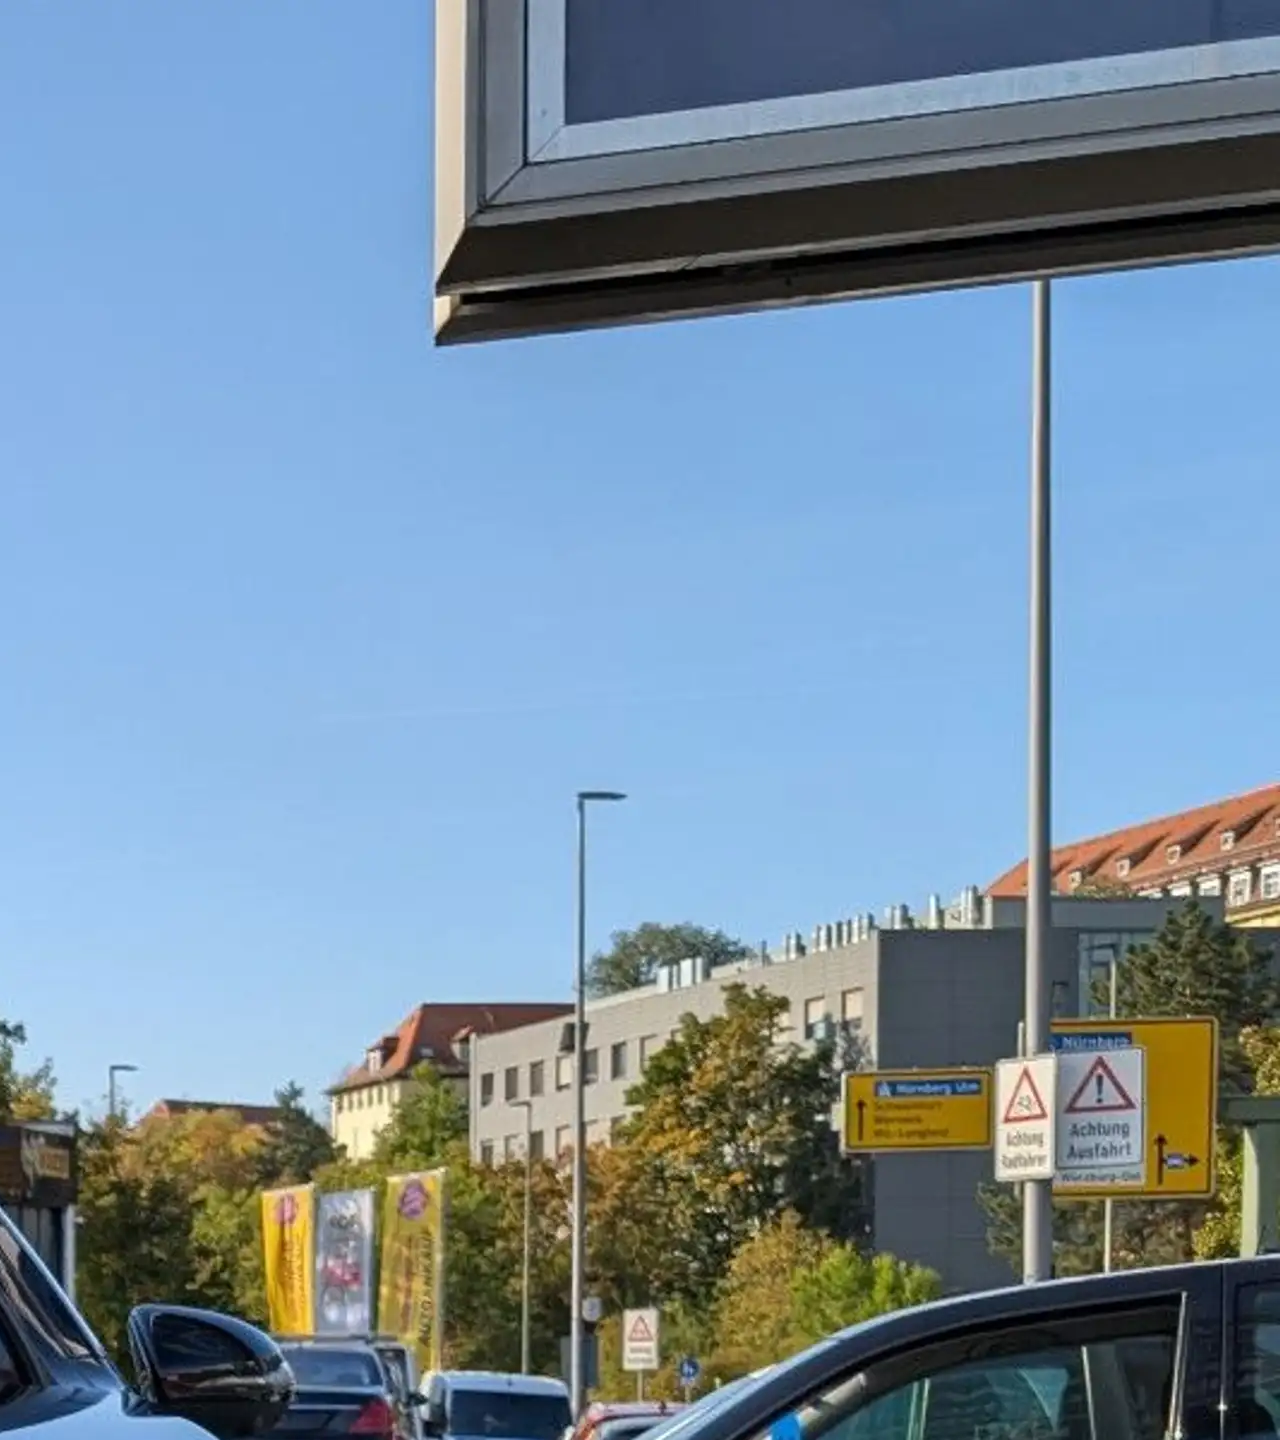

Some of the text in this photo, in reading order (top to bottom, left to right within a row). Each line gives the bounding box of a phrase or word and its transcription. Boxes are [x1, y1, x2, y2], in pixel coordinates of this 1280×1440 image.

[1069, 1123, 1130, 1138] Achtung
[1006, 1131, 1044, 1147] Achtung
[1067, 1142, 1132, 1160] Ausfahrt
